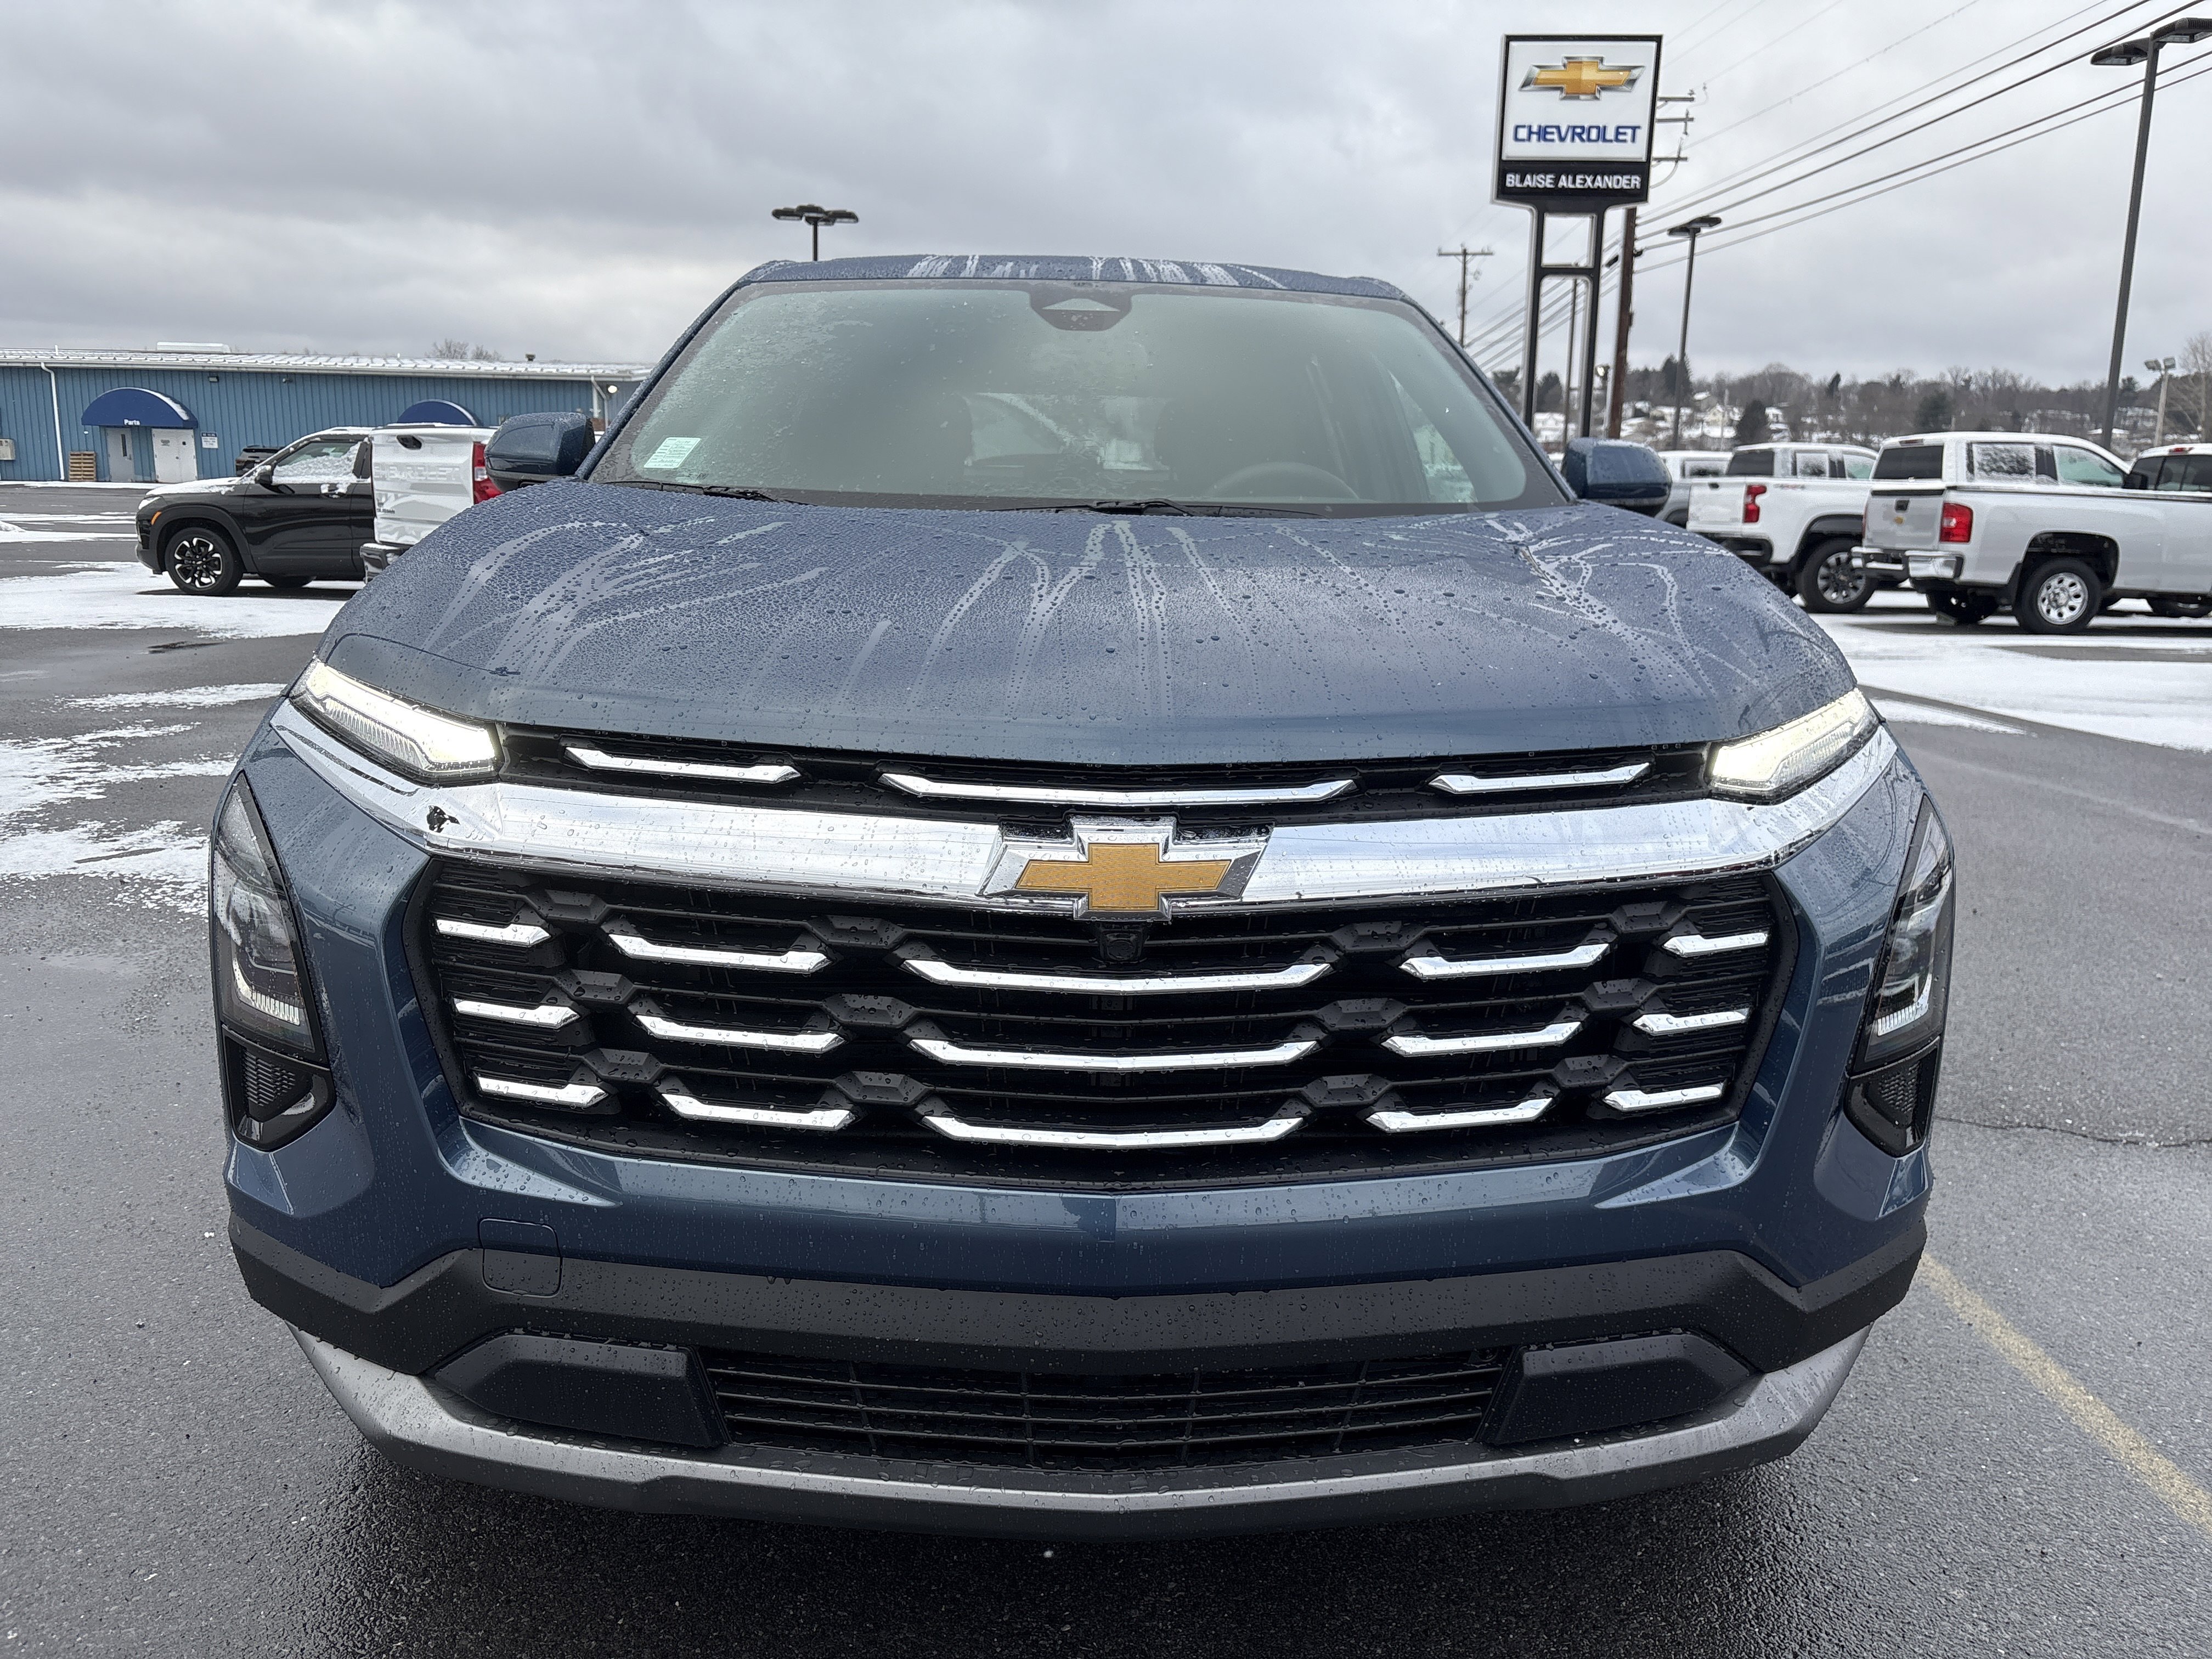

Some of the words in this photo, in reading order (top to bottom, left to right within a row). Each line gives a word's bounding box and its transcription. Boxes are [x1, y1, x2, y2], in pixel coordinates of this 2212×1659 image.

[1513, 125, 1641, 143] CHEVROLET
[1505, 173, 1555, 188] BLAISE
[1558, 174, 1641, 189] ALEXANDER
